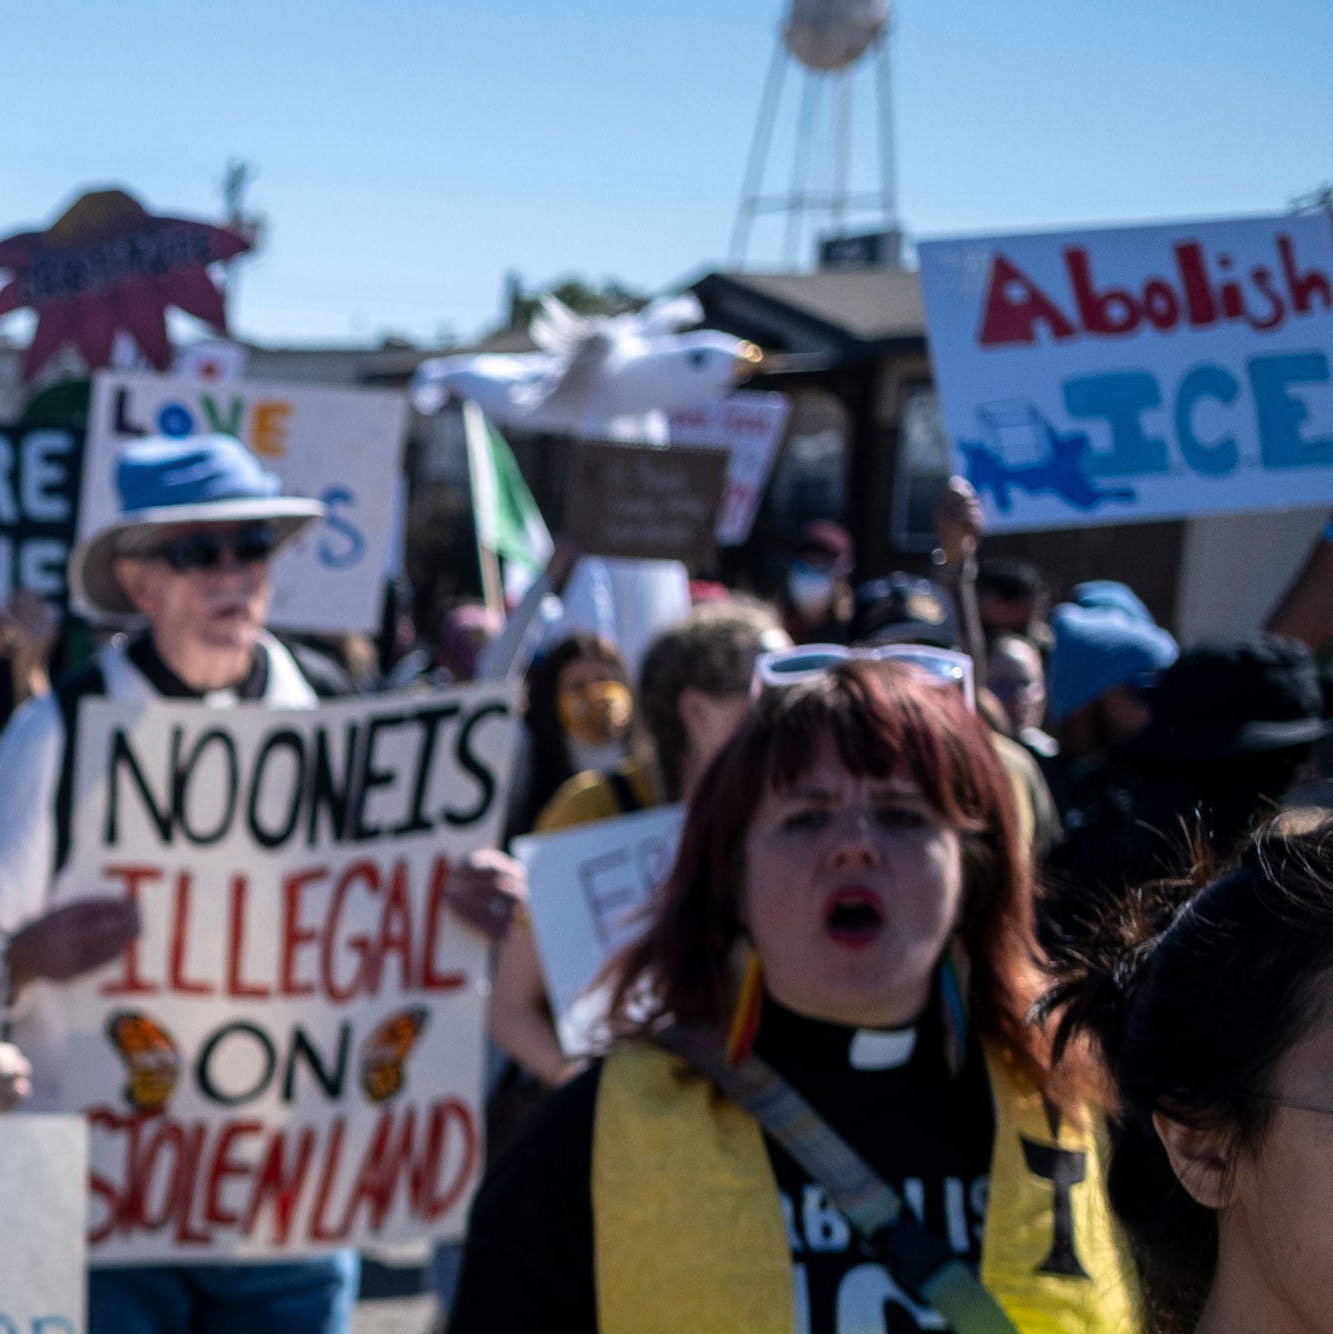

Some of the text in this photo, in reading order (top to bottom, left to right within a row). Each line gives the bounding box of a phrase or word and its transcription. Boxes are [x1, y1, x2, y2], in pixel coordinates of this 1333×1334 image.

[976, 232, 1333, 354] Abolish
[111, 384, 297, 460] LOVE
[1059, 348, 1333, 480] ICE
[99, 851, 467, 1005] ILLEGAL
[193, 1017, 355, 1107] ON
